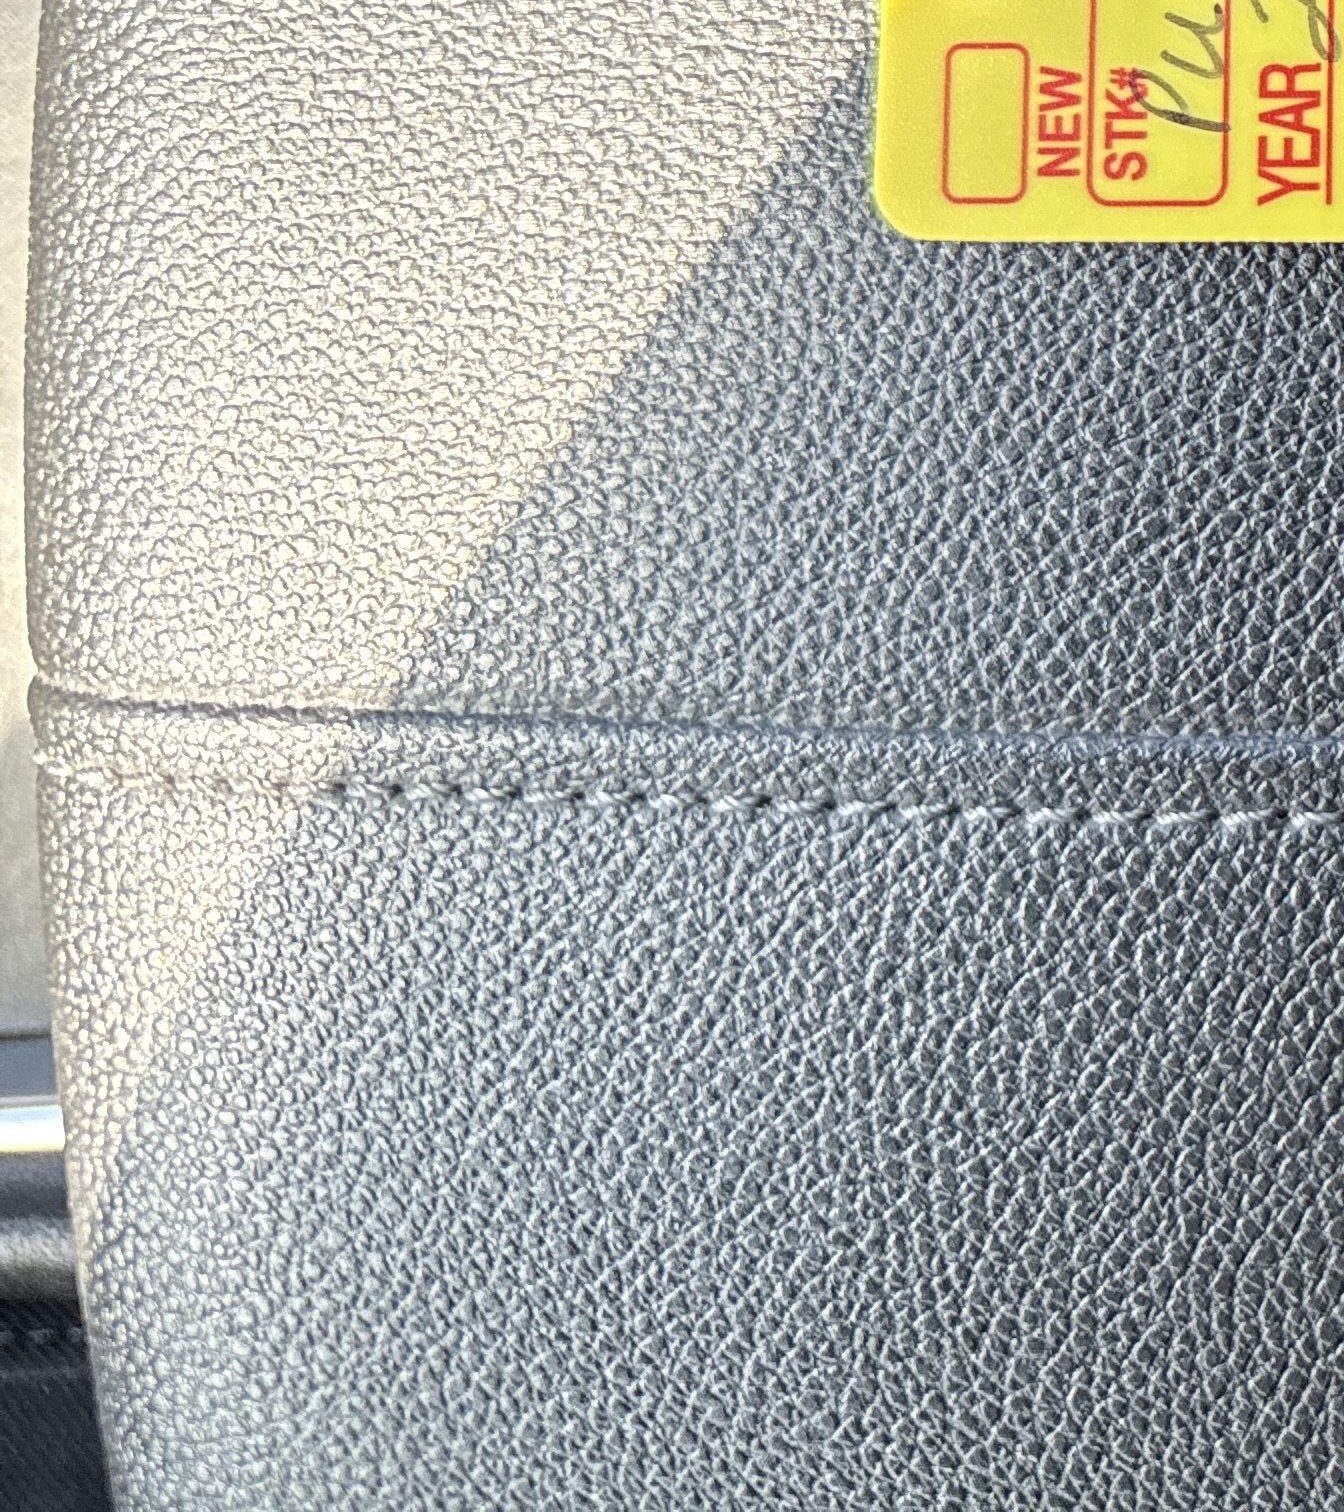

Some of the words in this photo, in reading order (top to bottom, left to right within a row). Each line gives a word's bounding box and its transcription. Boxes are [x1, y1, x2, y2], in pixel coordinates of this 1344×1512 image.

[1037, 67, 1083, 178] NEW
[1105, 67, 1150, 181] STK#
[1257, 62, 1321, 206] YEAR
